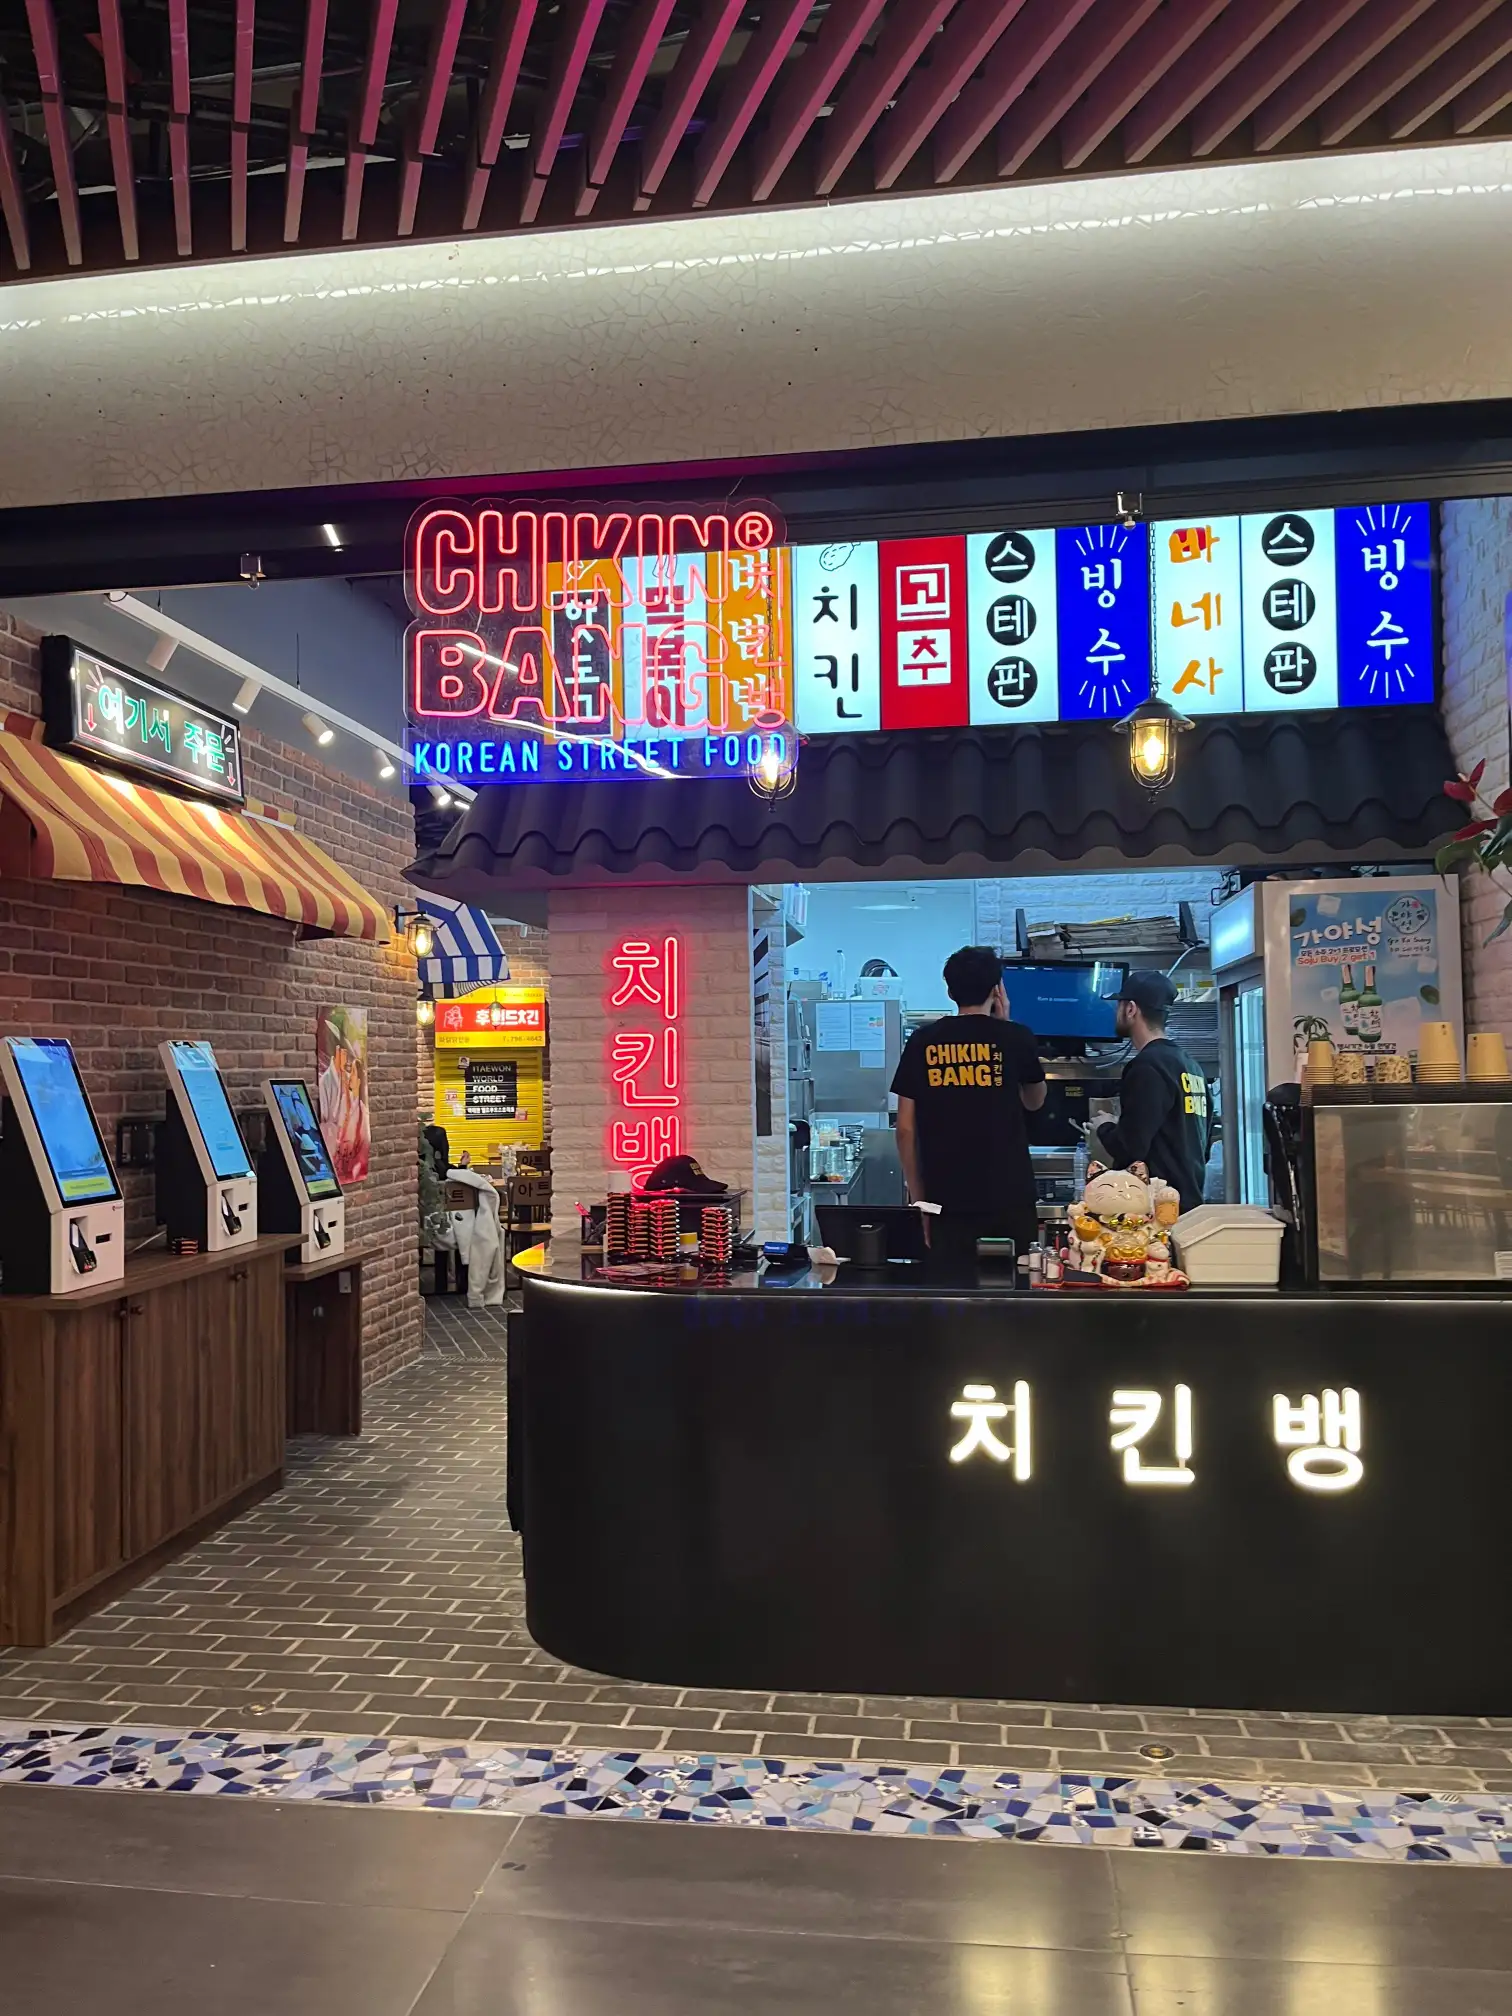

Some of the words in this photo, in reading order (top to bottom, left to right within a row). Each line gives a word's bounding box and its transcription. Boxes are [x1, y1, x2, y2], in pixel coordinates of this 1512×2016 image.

[896, 563, 951, 687] 고추
[990, 540, 1031, 701] 스테판
[1080, 558, 1126, 676] 빙수
[1266, 522, 1309, 688] 스테판
[1361, 538, 1410, 661] 빙수
[414, 620, 729, 731] BANG
[812, 583, 863, 718] 치킨
[98, 685, 171, 753] 여기서
[184, 720, 225, 774] 주문
[414, 740, 540, 775] KOREAN
[557, 738, 685, 772] STREET
[705, 734, 787, 767] FOOD
[1293, 916, 1383, 947] 가야성
[1320, 955, 1338, 963] Buy
[1341, 953, 1348, 961] 2
[472, 1064, 512, 1073] ITAEWON
[472, 1075, 504, 1083] WORLD
[472, 1085, 498, 1093] FOOD
[472, 1095, 507, 1104] STREET
[611, 936, 680, 1190] 치킨뱅
[927, 1064, 992, 1087] BANG
